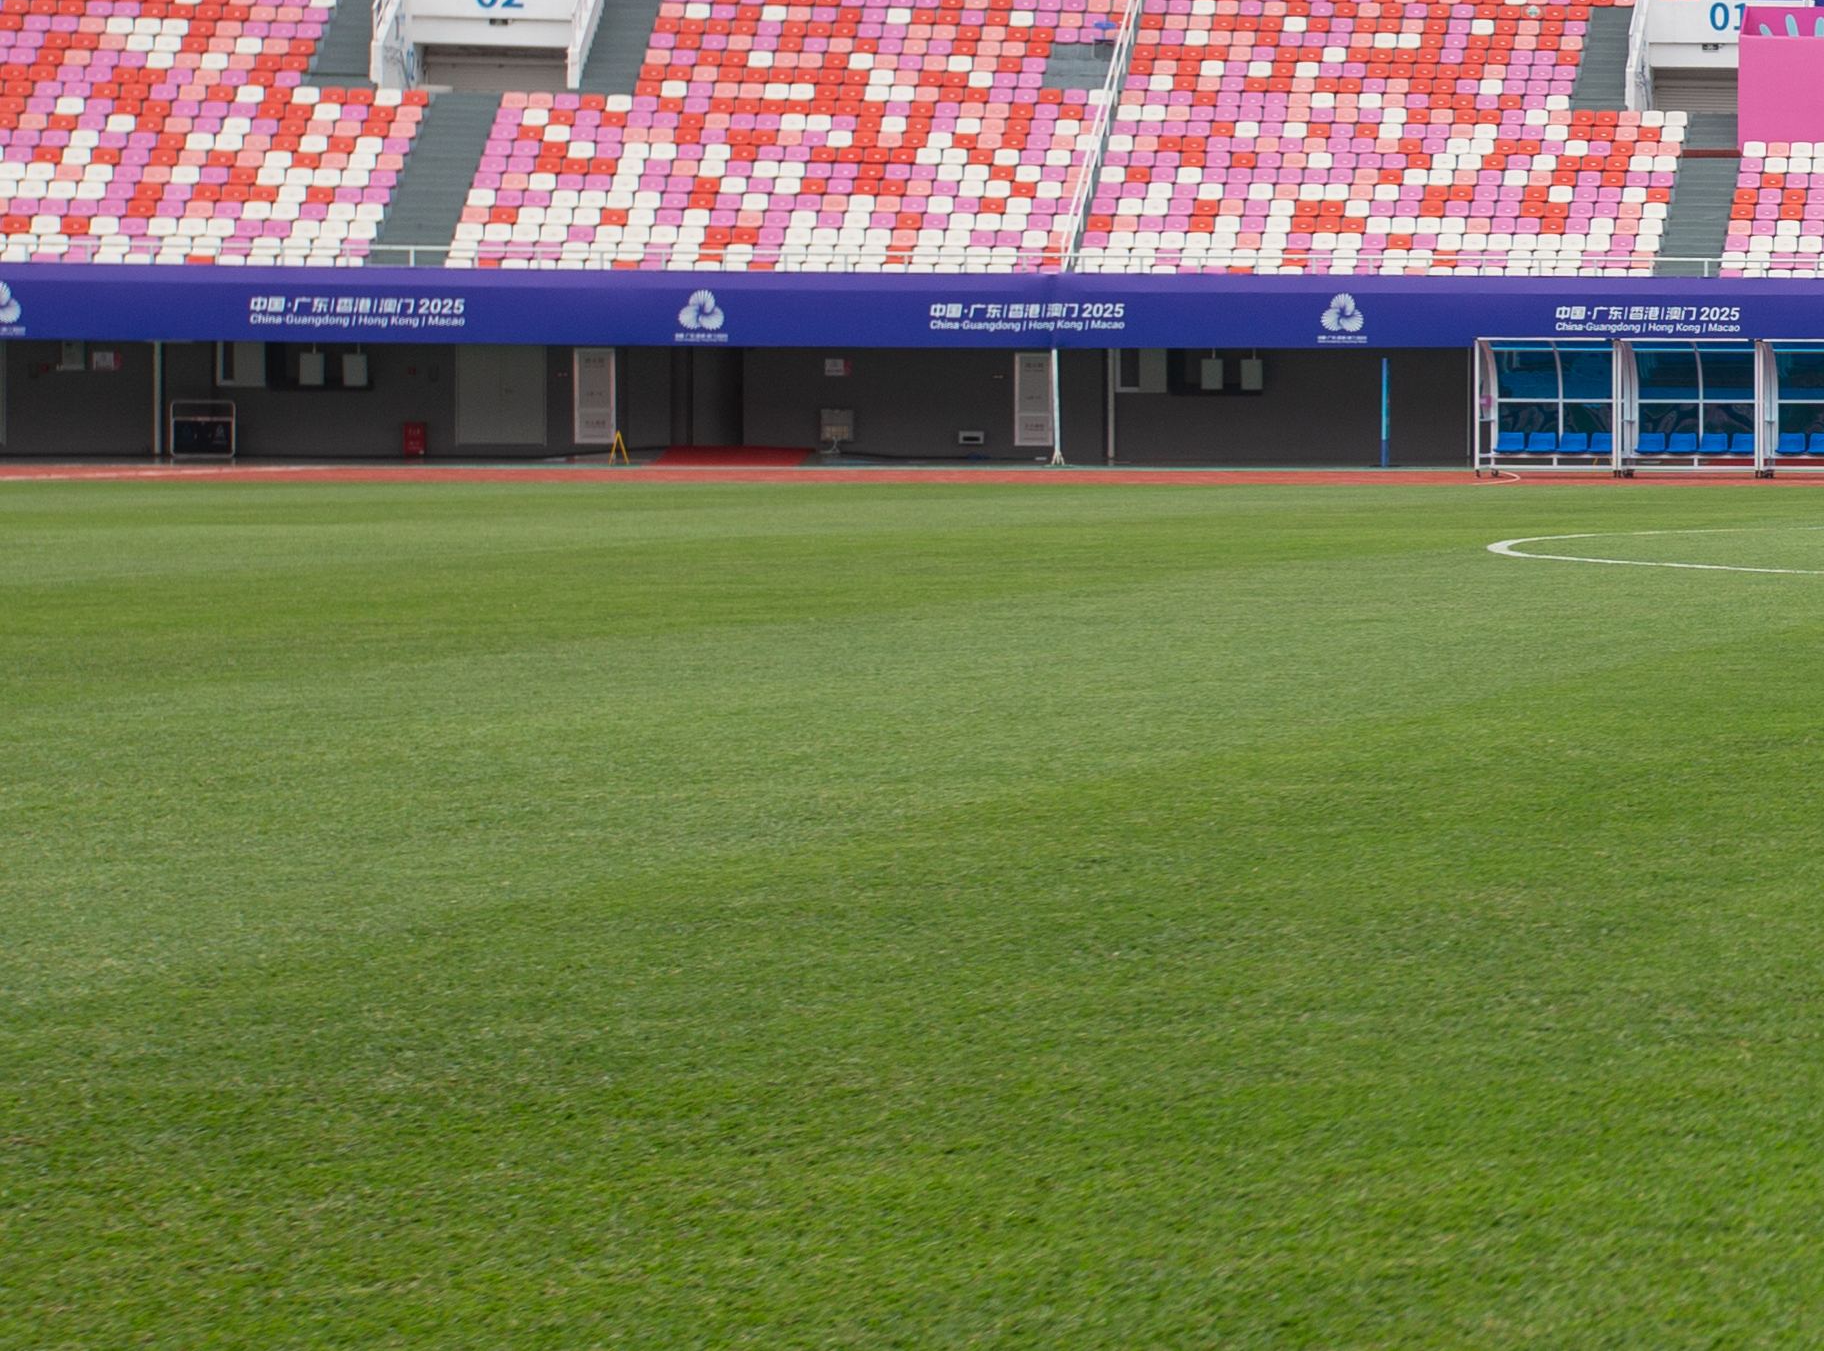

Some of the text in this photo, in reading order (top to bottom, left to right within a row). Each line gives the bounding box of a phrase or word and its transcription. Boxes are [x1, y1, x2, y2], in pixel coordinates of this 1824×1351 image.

[418, 299, 466, 314] 2025
[1081, 303, 1125, 317] 2025
[1699, 307, 1741, 320] 2025
[357, 316, 388, 327] Hong
[389, 316, 420, 327] Kong
[427, 316, 466, 326] Macao
[1028, 321, 1056, 330] Hong
[1056, 320, 1084, 330] Kong
[1090, 320, 1125, 329] Macao
[1647, 323, 1675, 333] Hong
[1675, 323, 1701, 333] Kong
[1707, 323, 1741, 331] Macao
